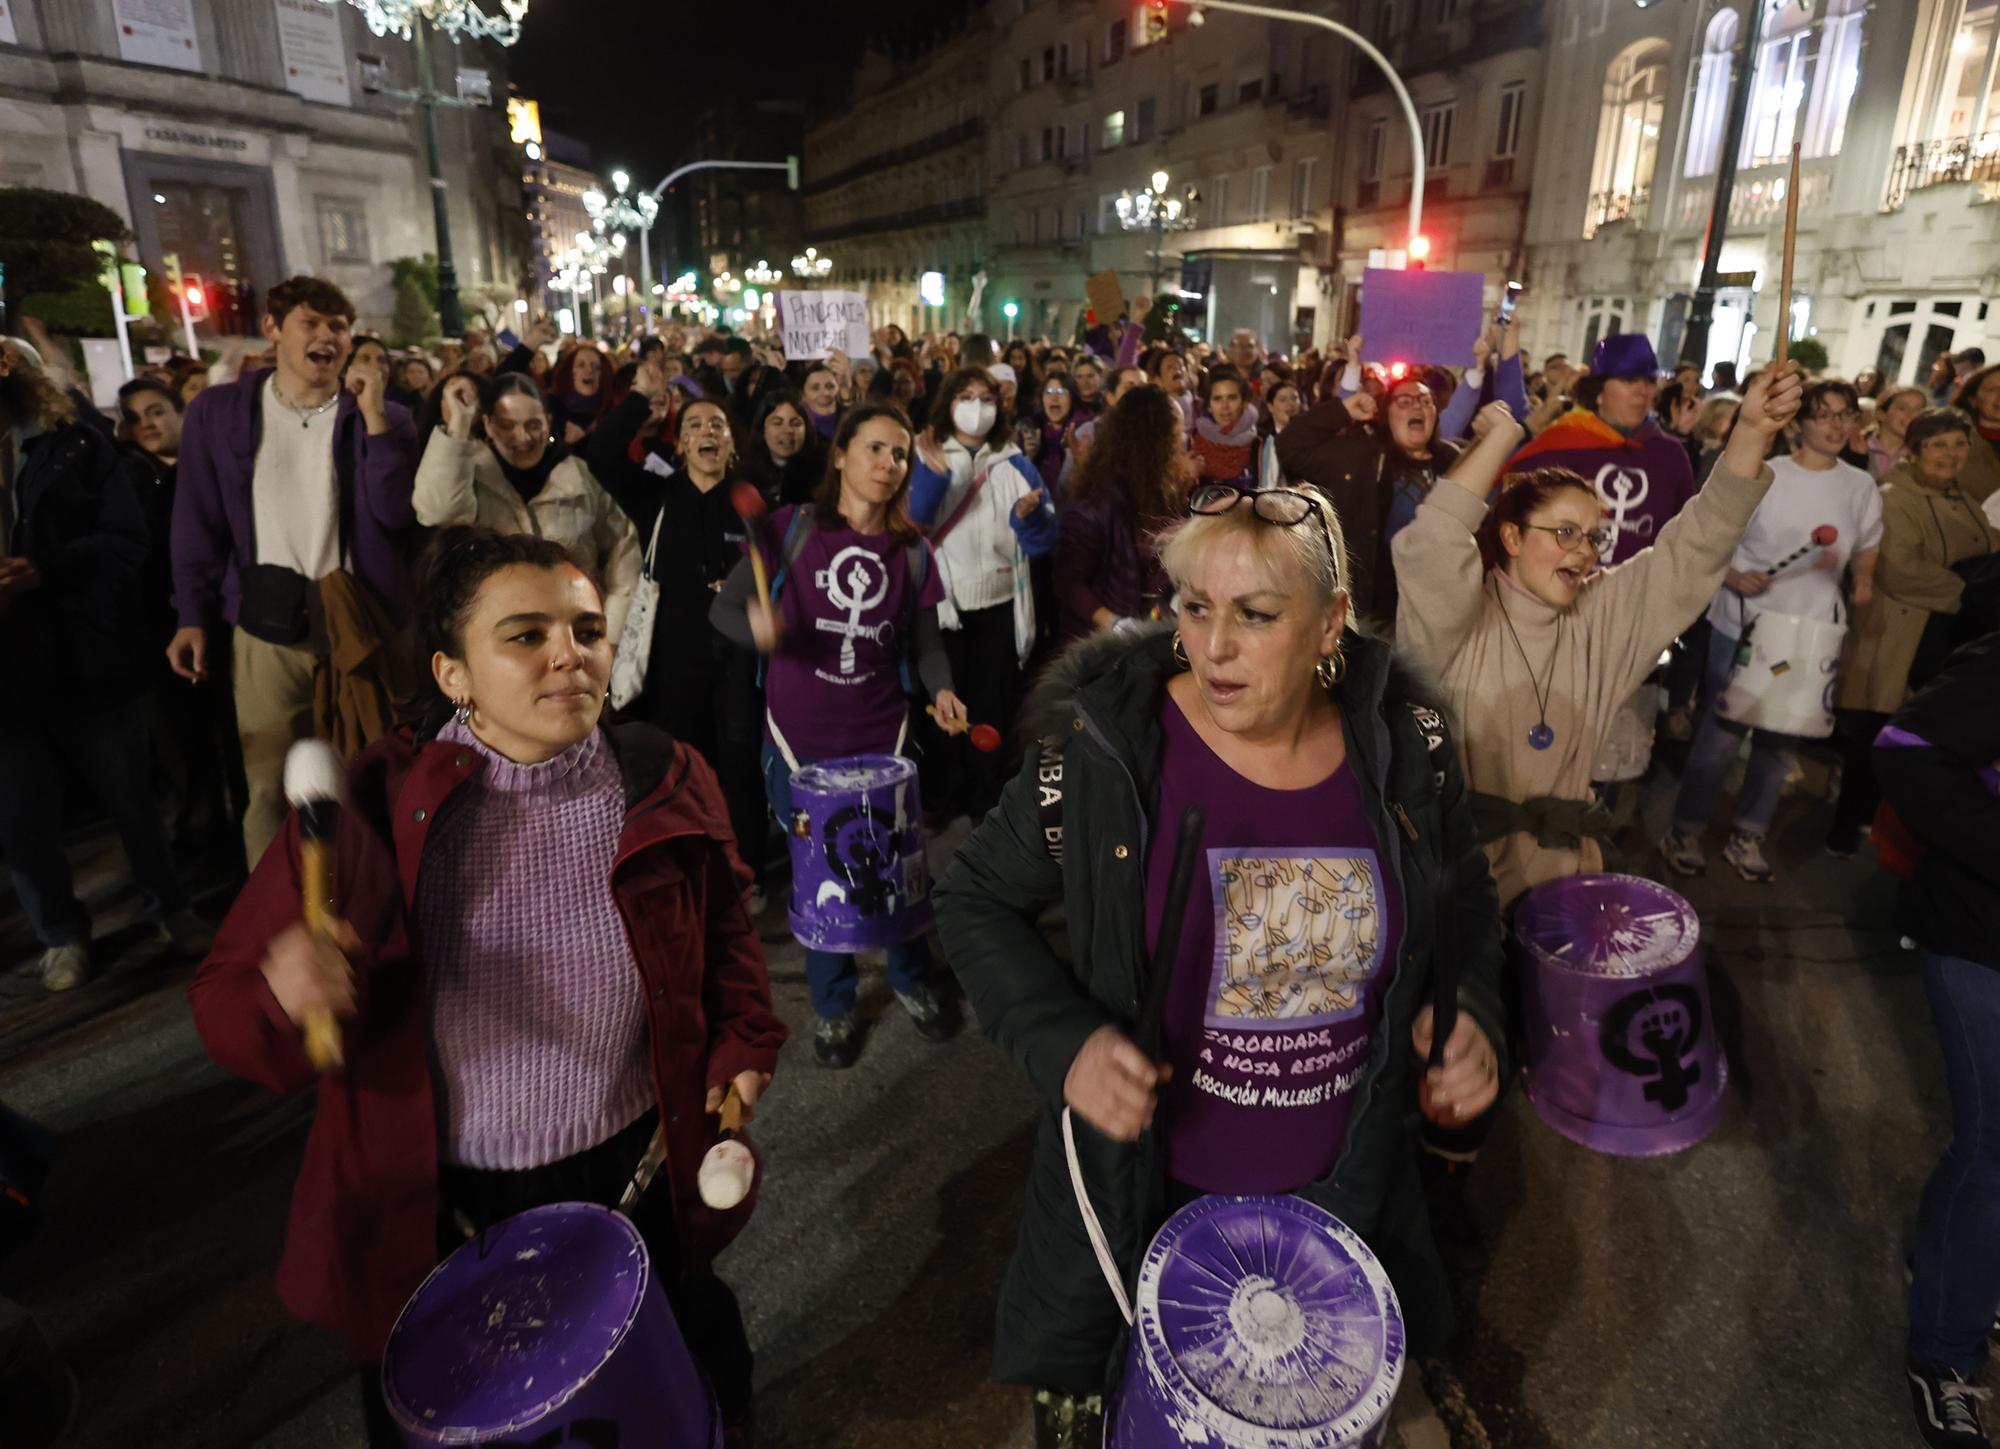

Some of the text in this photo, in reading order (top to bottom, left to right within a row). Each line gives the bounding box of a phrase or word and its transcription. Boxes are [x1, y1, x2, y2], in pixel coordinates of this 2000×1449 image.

[789, 295, 865, 324] PANDEMIA
[1199, 1047, 1214, 1064] A
[1222, 1053, 1281, 1077] NOSA
[1191, 1067, 1260, 1106] ASOCIACIÓN
[1261, 1084, 1322, 1108] MULLERES
[1324, 1081, 1331, 1101] E
